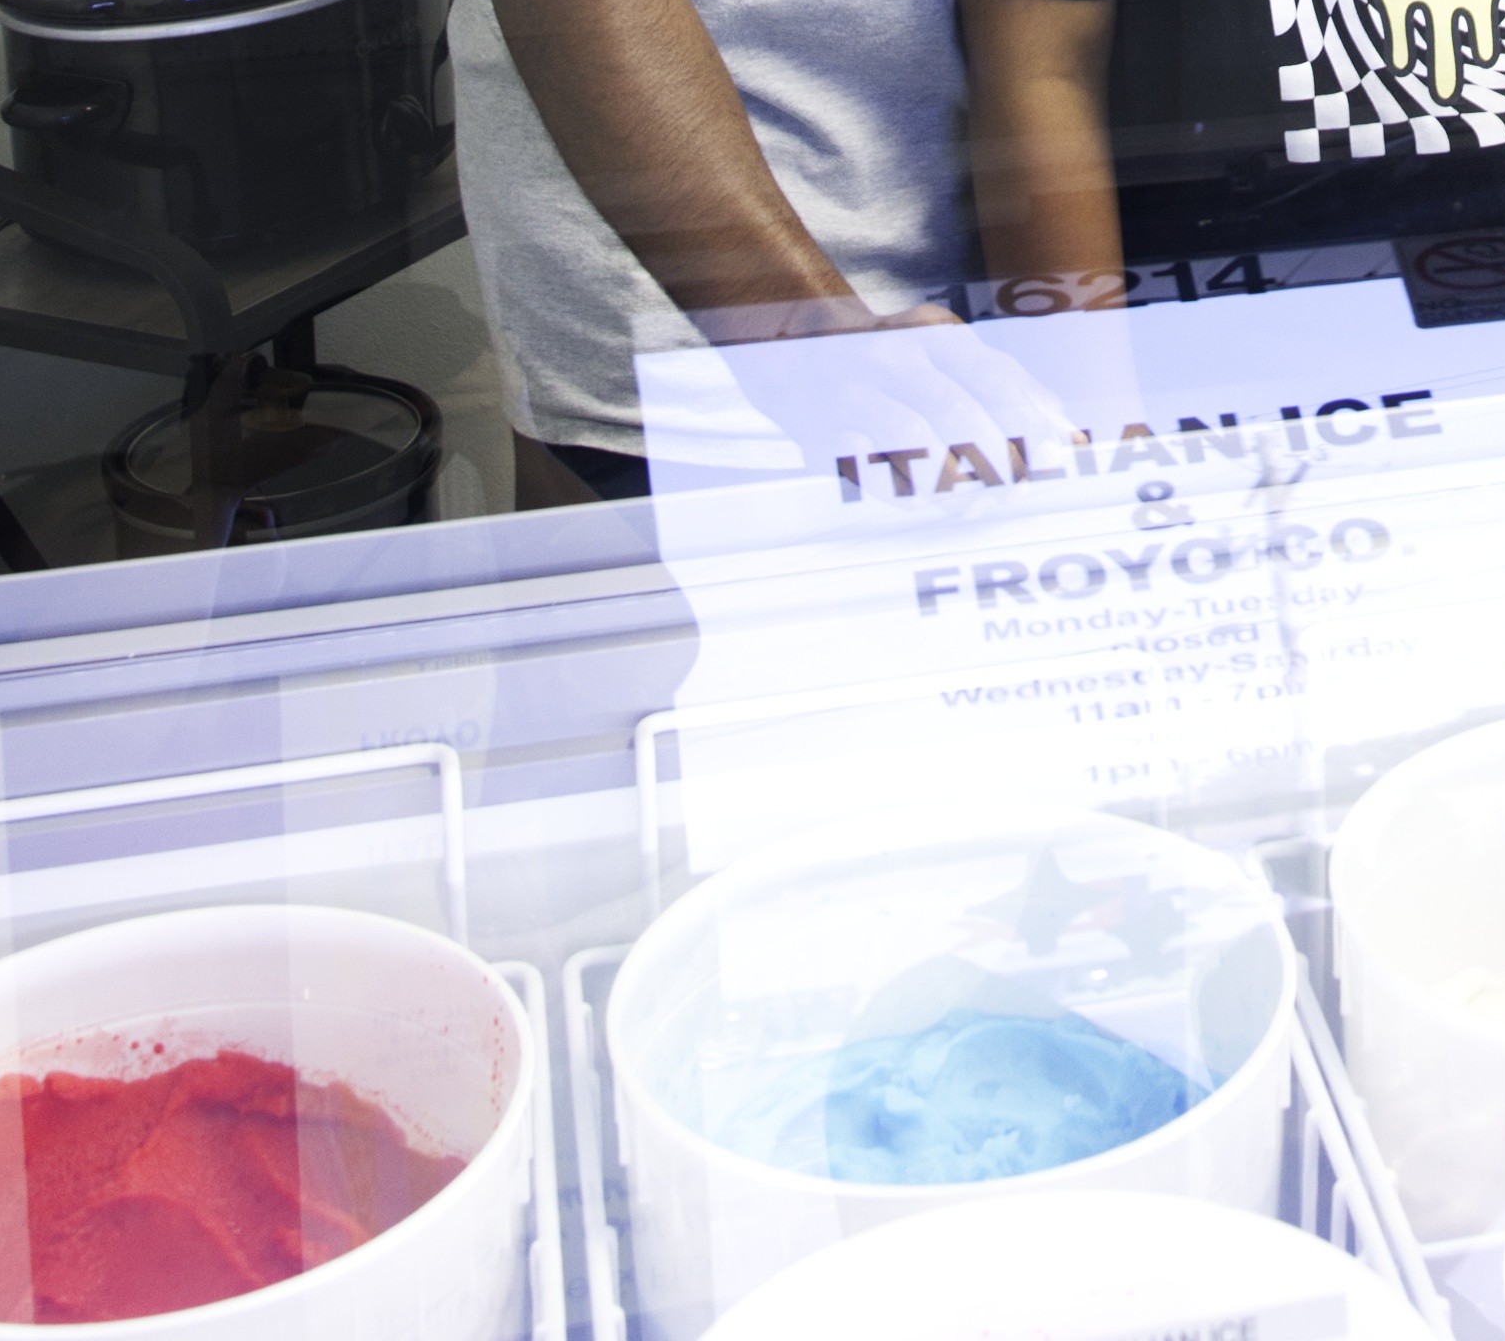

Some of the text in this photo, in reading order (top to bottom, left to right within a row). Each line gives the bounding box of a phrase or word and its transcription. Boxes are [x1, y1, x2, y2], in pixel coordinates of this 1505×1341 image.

[834, 389, 1444, 504] ITALIAN ICE
[1131, 479, 1194, 533] &
[913, 536, 1236, 616] FROYO
[981, 581, 1366, 643] Monday-Tuesday
